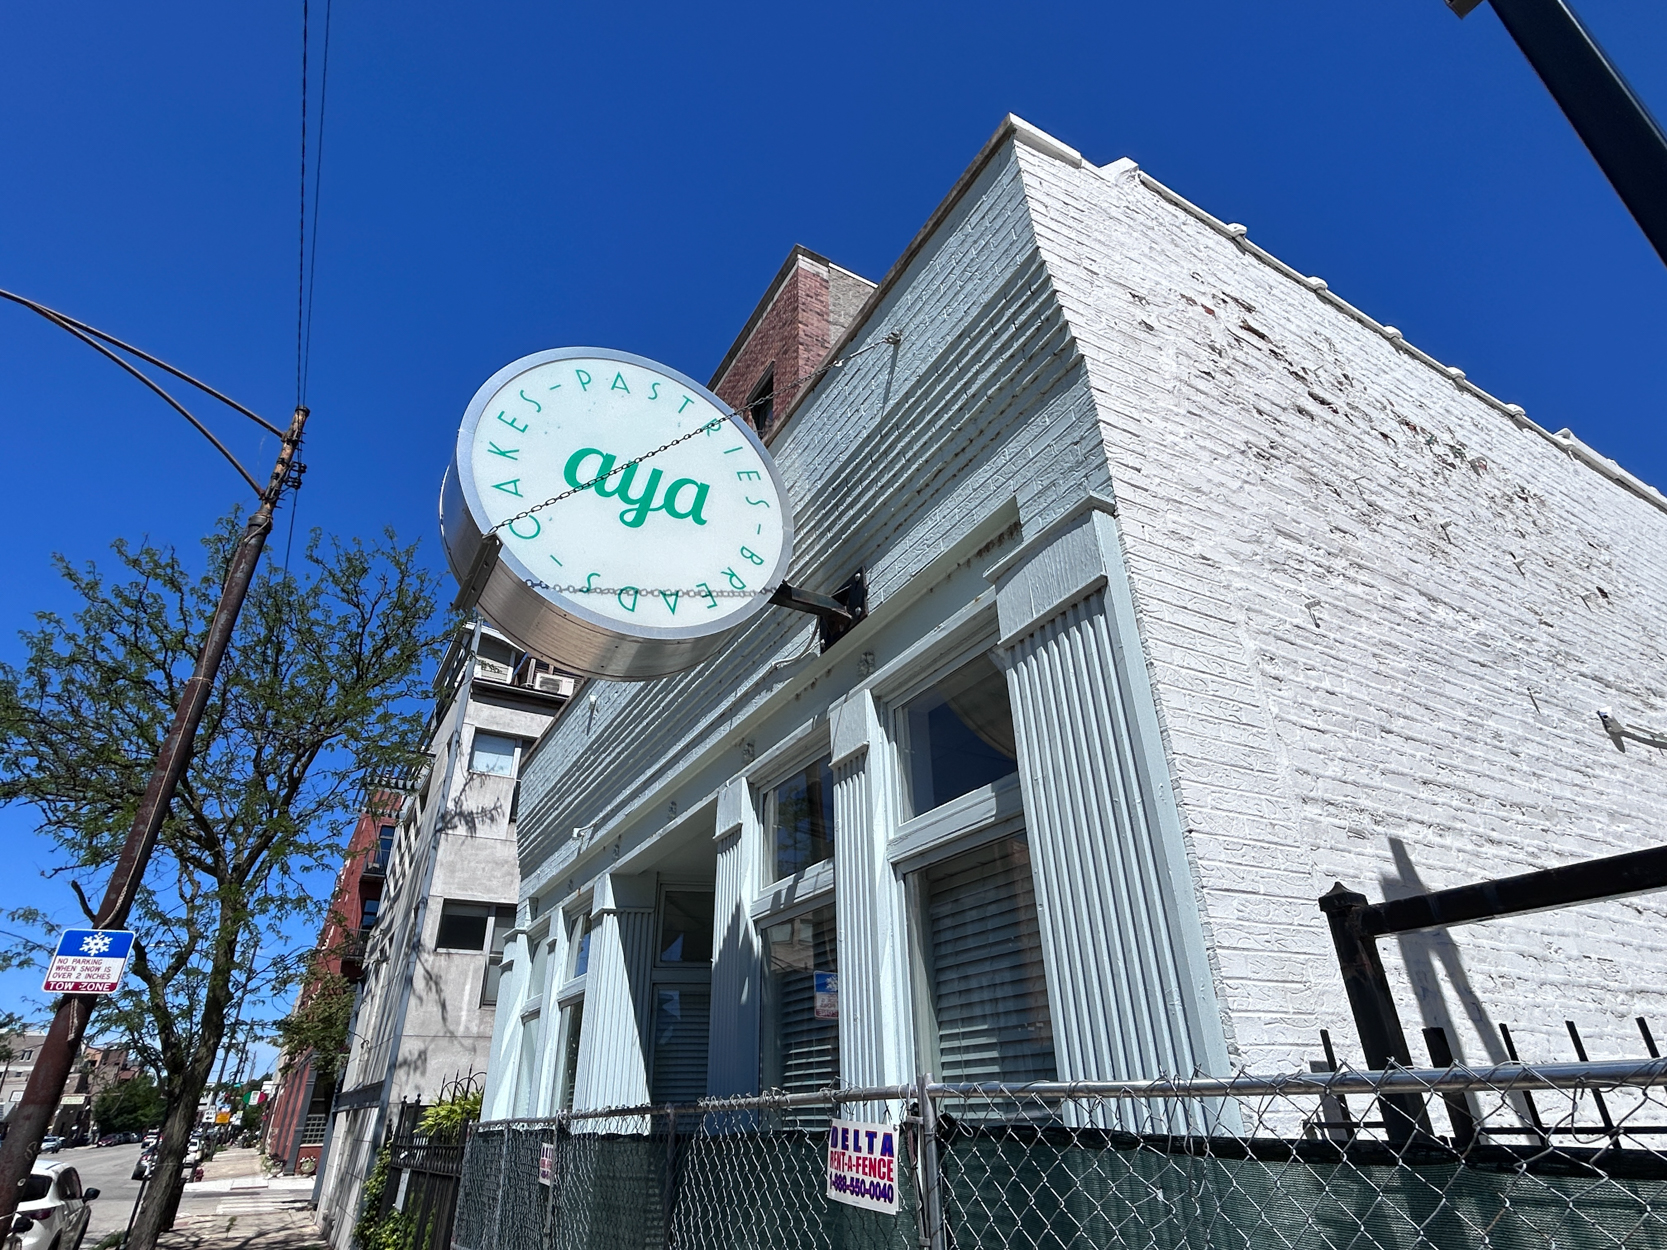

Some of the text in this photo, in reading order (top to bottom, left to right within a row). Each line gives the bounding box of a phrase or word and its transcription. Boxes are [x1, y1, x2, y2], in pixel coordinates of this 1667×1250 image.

[563, 447, 710, 528] aya
[49, 981, 111, 991] TOW ZONE
[830, 1126, 894, 1158] DELTA
[830, 1150, 894, 1182] RENT-A-FENCE
